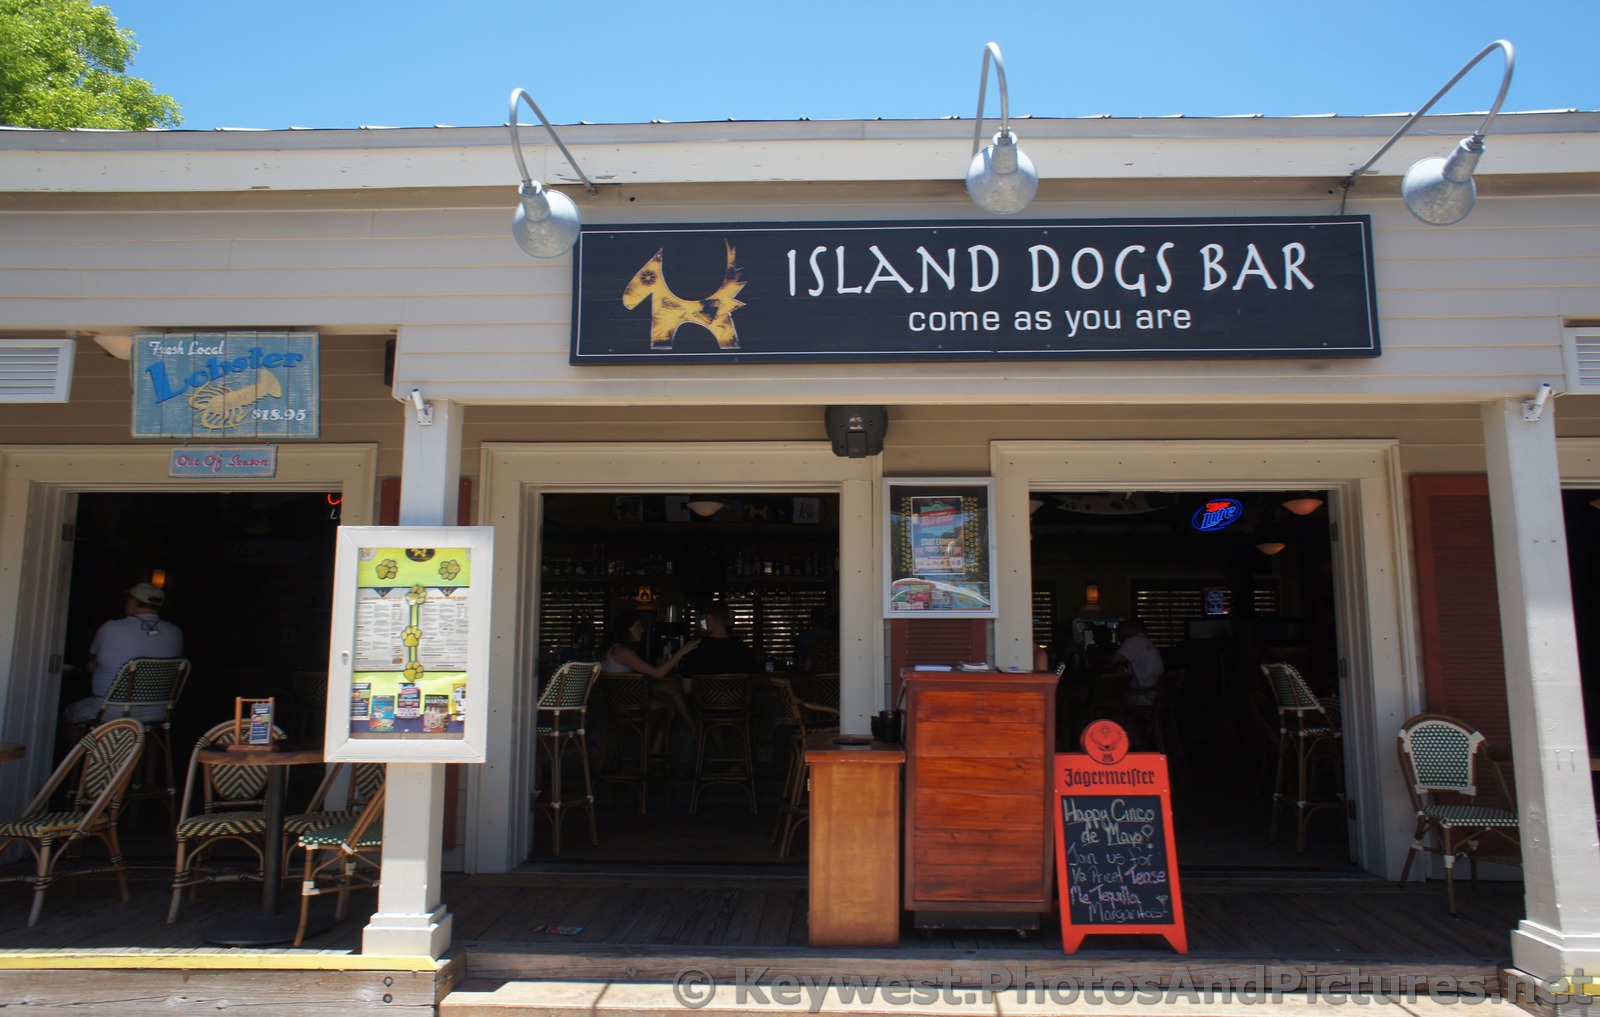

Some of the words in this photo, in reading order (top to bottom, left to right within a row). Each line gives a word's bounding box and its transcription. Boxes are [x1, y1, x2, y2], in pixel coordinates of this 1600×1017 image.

[786, 244, 1000, 297] ISLAND
[1027, 241, 1175, 298] DOGS
[1199, 242, 1315, 291] BAR
[908, 310, 1000, 332] come
[1014, 310, 1053, 331] as
[1064, 309, 1122, 338] you
[1135, 308, 1192, 330] are
[149, 340, 184, 356] Fresh
[187, 340, 225, 356] Local
[145, 346, 305, 405] Lobster
[251, 408, 307, 422] $18.95
[176, 454, 199, 467] Out
[226, 454, 268, 468] Season
[1200, 506, 1236, 528] Lite
[1063, 768, 1155, 787] Jägermeister
[1063, 798, 1110, 831] Happy
[1111, 798, 1155, 822] Cinco
[1081, 827, 1100, 844] de
[1067, 842, 1098, 866] Join
[1106, 853, 1126, 866] us
